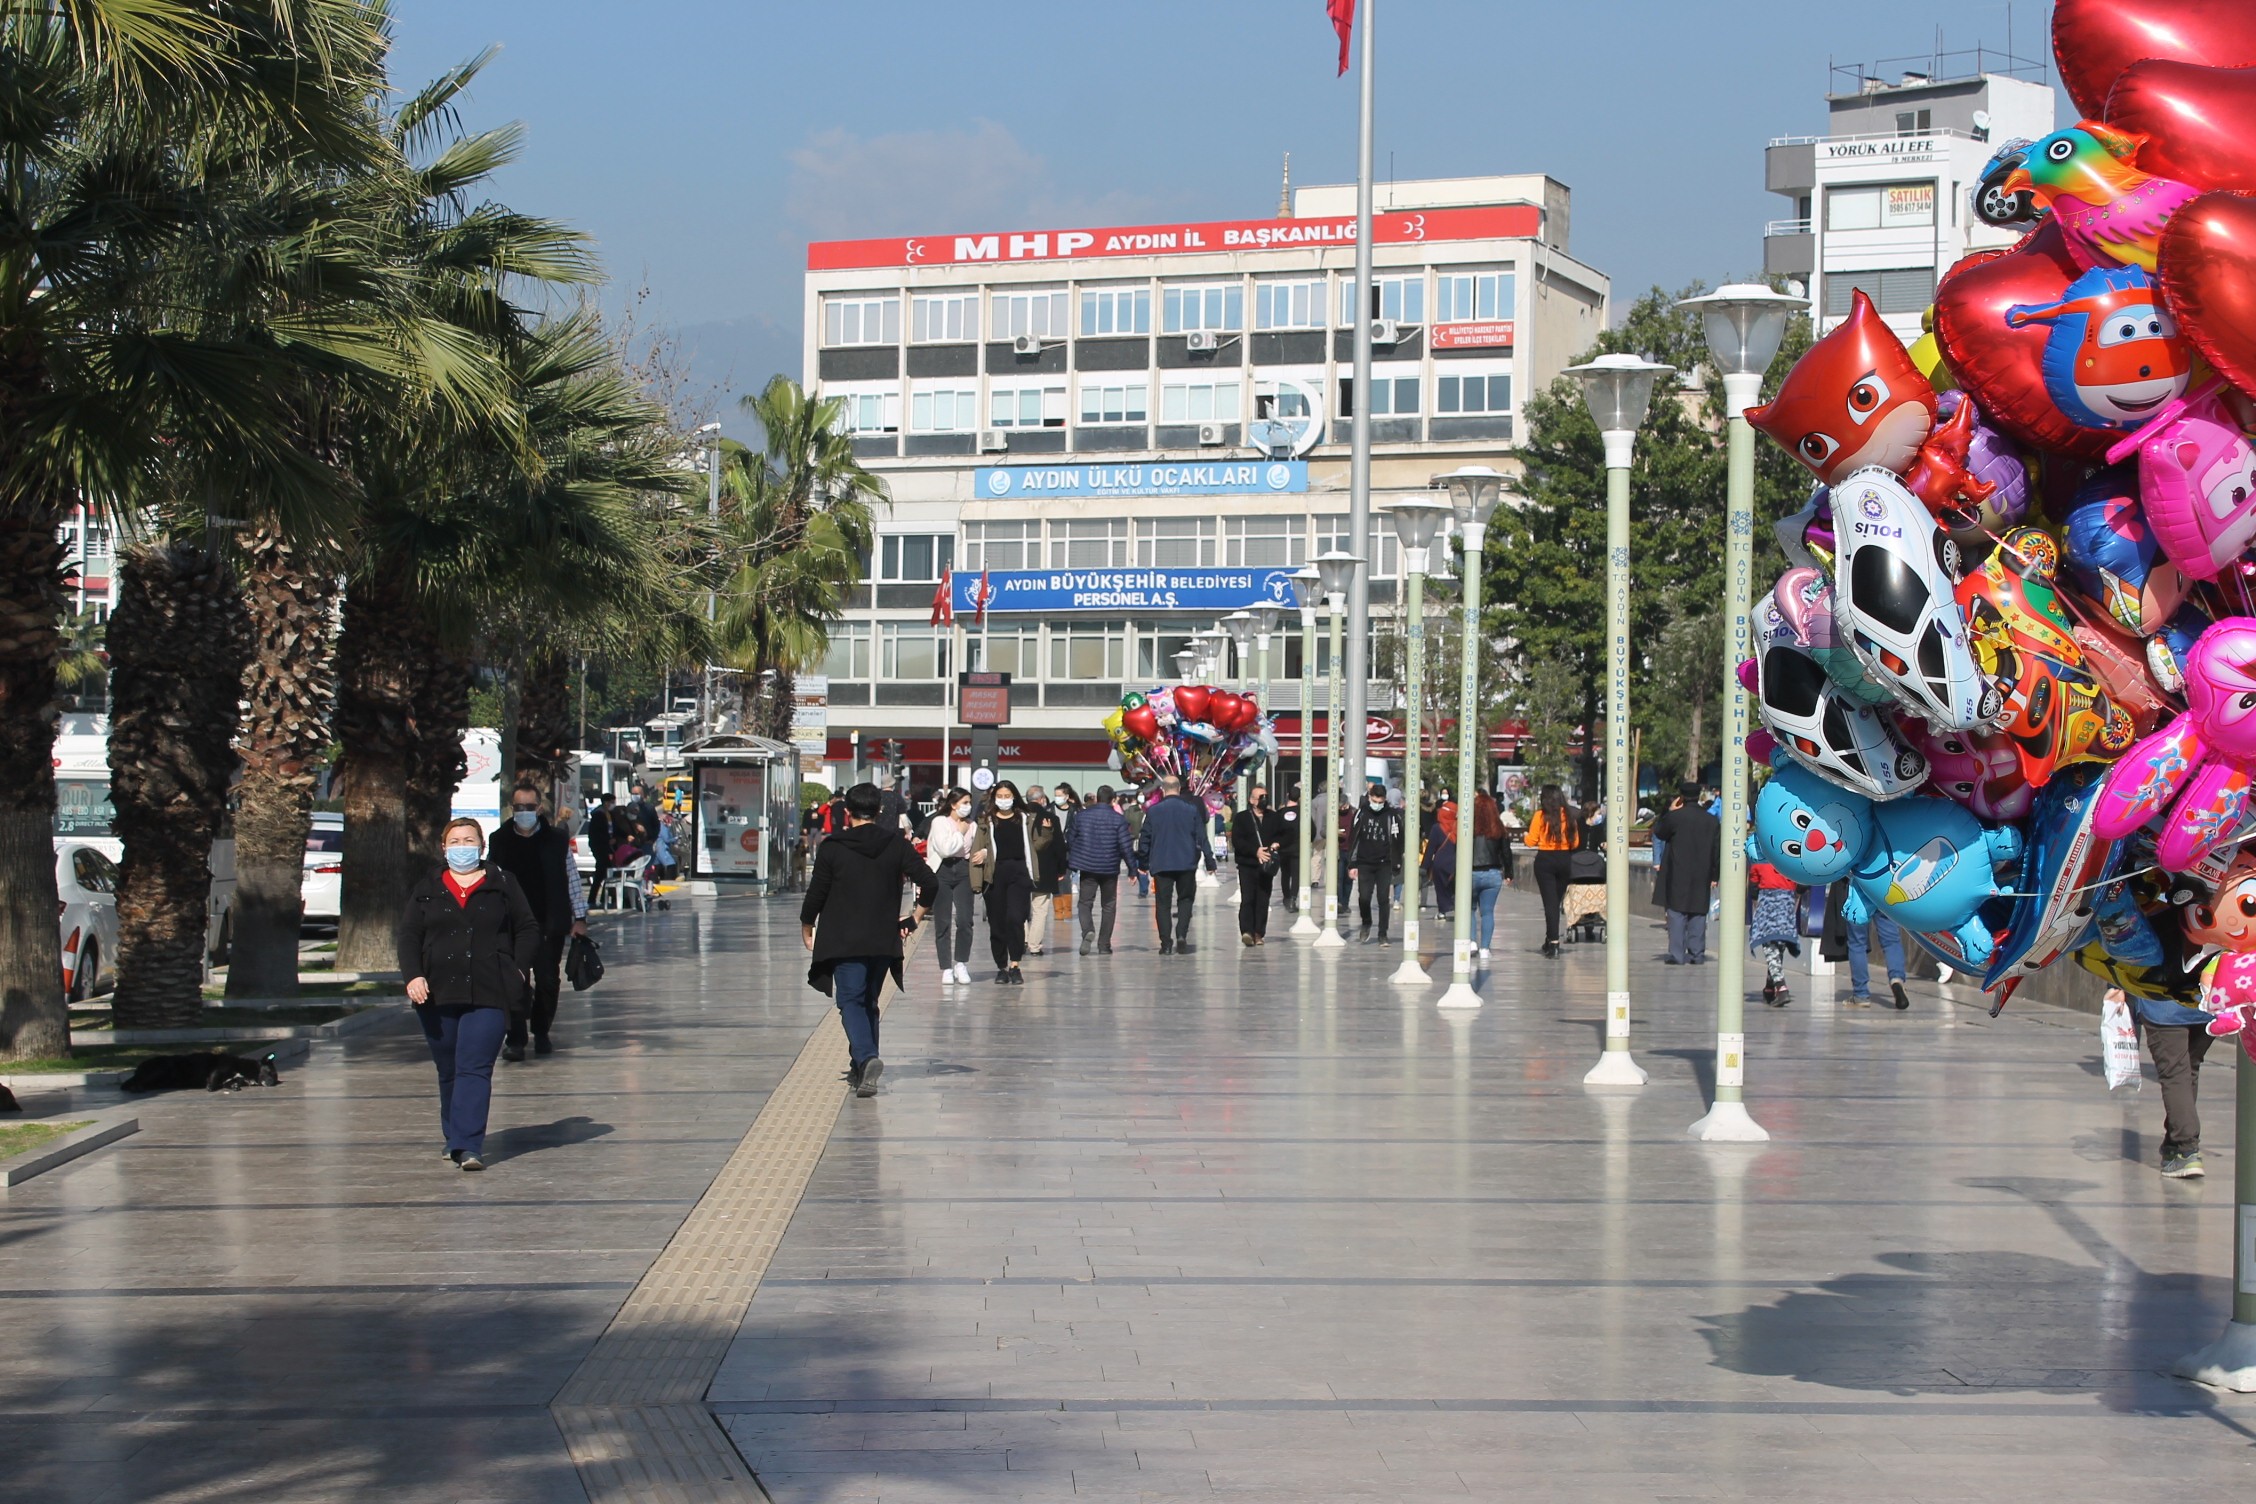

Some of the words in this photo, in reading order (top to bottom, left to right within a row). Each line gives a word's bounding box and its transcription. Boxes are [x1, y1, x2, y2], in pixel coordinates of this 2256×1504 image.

[1829, 143, 1878, 156] YÖRÜK
[1881, 140, 1904, 153] ALİ
[1908, 140, 1934, 151] EFE
[1890, 188, 1931, 203] SATILIK
[954, 232, 1094, 260] MHP
[1106, 234, 1176, 250] AYDIN
[1184, 228, 1205, 247] İL
[1224, 220, 1357, 248] BAŞKANLIĞ
[1022, 470, 1079, 490] AYDIN
[1088, 464, 1142, 488] ÜLKÜ
[1151, 466, 1257, 486] OCAKLARI
[1855, 522, 1902, 538] POLİS
[1004, 579, 1047, 591] AYDIN
[1051, 571, 1167, 593] BÜYÜKŞEHİR
[1170, 574, 1252, 589] BELEDİYESİ
[1737, 559, 1746, 602] AYDIN
[1074, 592, 1148, 606] PERSONEL
[1151, 592, 1179, 608] A.Ş.
[1616, 636, 1625, 746] BÜYÜKŞEHİR
[1965, 698, 1974, 722] 155
[953, 746, 1021, 756] AKNK
[1881, 762, 1893, 785] 155
[2196, 863, 2220, 879] ULANS
